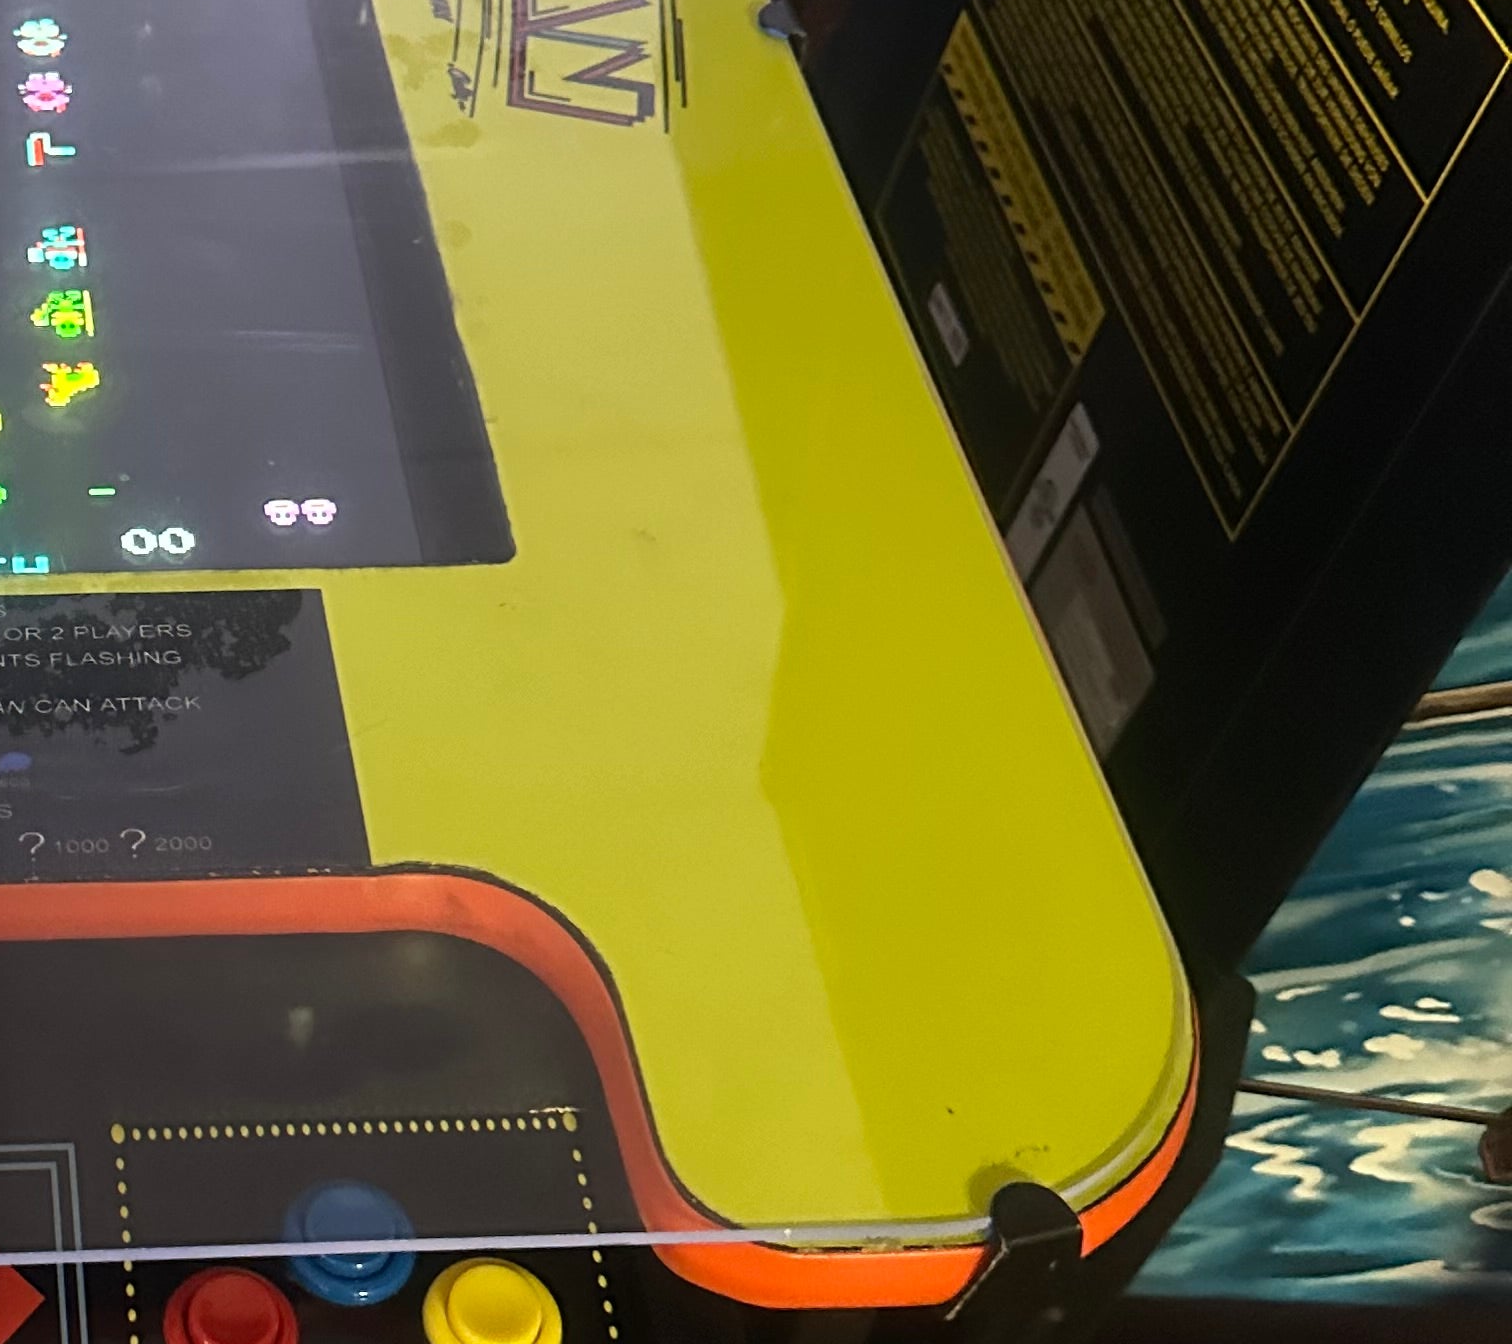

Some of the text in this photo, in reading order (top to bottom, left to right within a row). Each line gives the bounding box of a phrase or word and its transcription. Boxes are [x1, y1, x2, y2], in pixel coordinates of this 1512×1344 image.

[3, 627, 41, 643] OR
[51, 626, 64, 641] 2
[74, 623, 193, 640] PLAYERS
[50, 649, 183, 668] FLASHING
[35, 698, 91, 714] CAN
[100, 696, 202, 712] ATTACK
[18, 831, 45, 862] ?
[55, 838, 110, 854] 1000
[120, 828, 147, 859] ?
[155, 836, 212, 852] 2000
